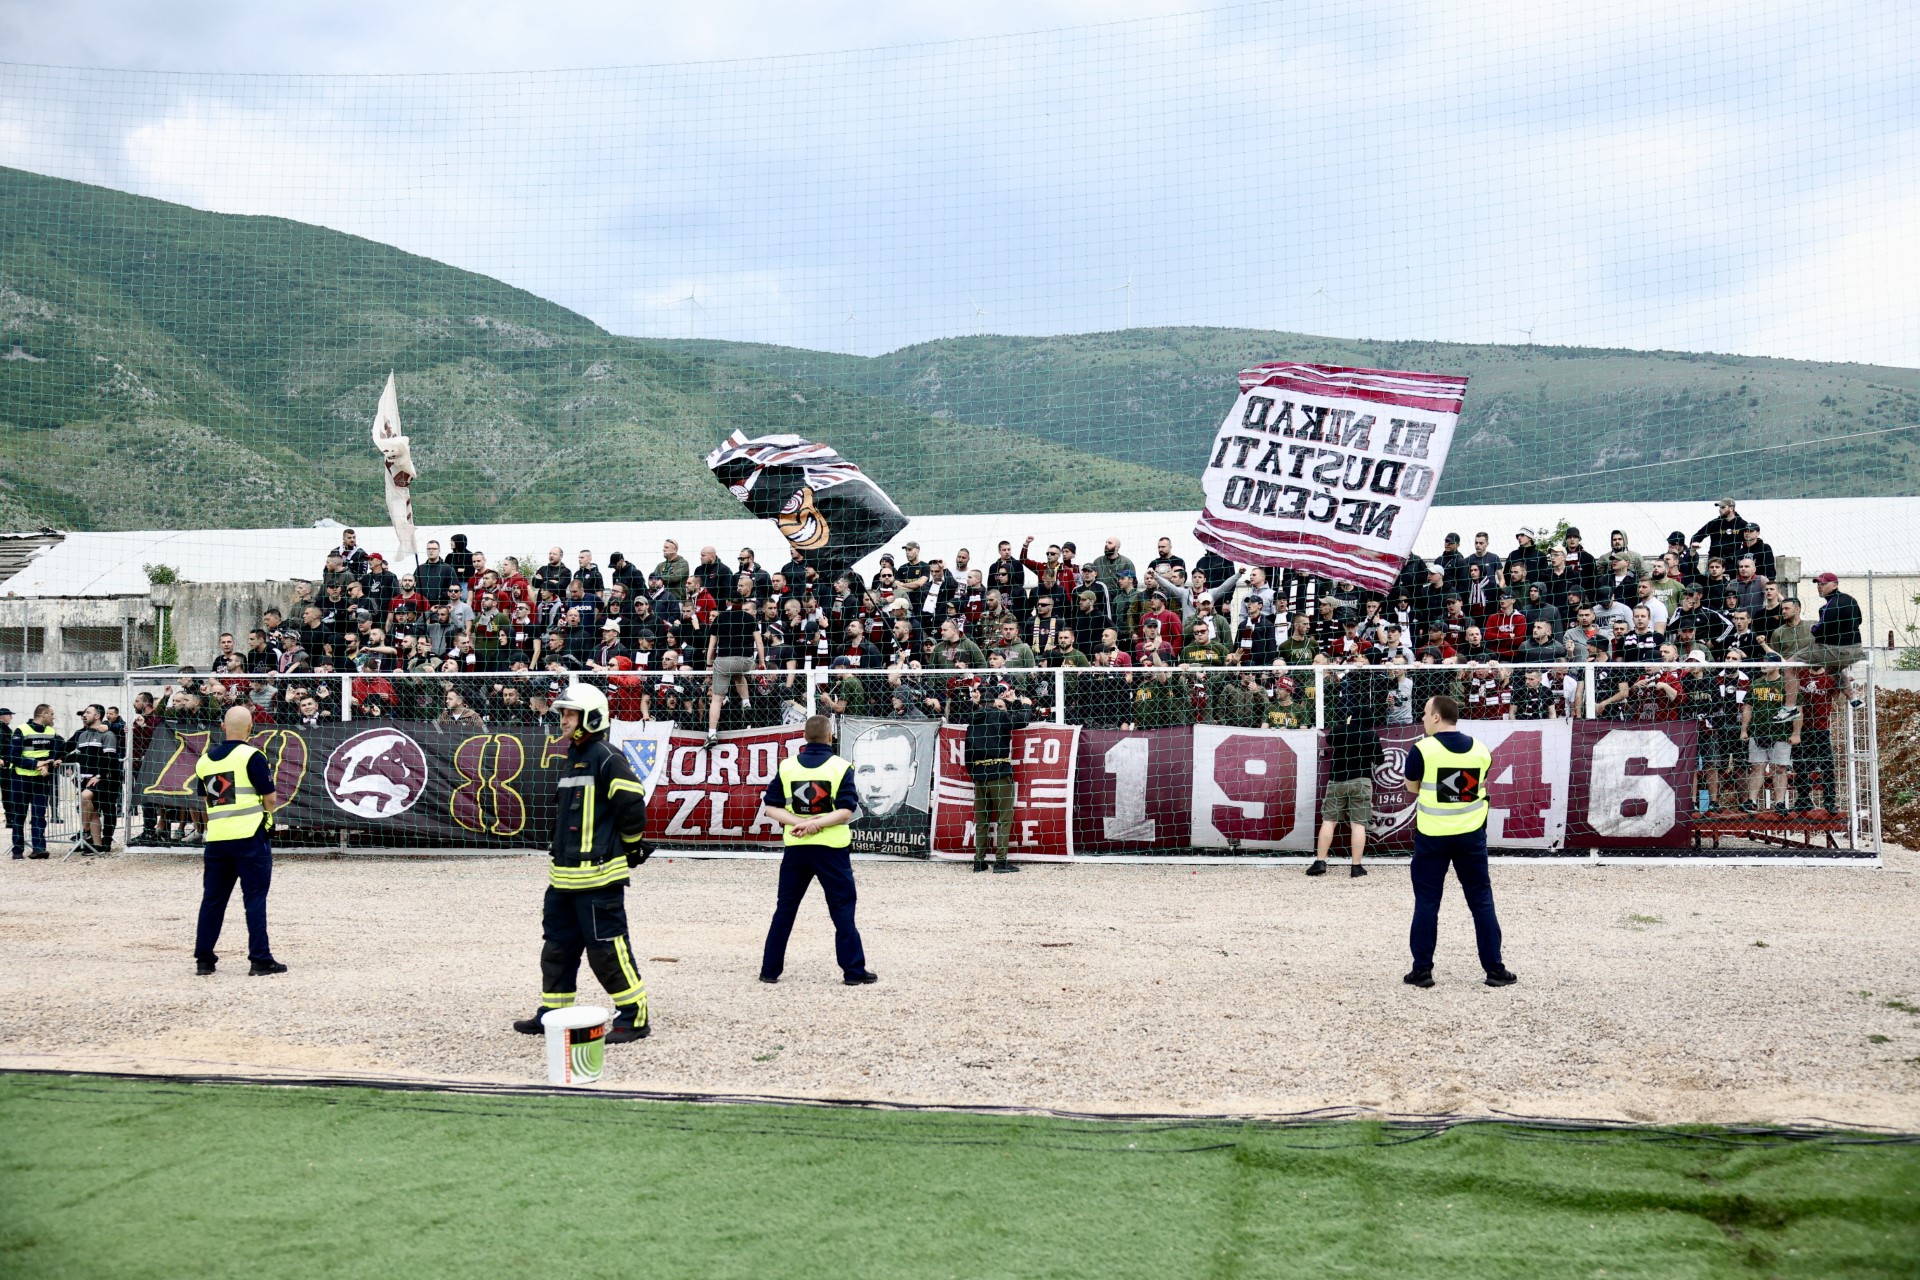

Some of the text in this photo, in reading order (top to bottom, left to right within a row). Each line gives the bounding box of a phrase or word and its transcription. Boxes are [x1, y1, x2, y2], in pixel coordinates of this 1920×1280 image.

[1379, 793, 1403, 804] 1946
[850, 829, 882, 842] ORAN
[851, 842, 909, 854] 1985-2009
